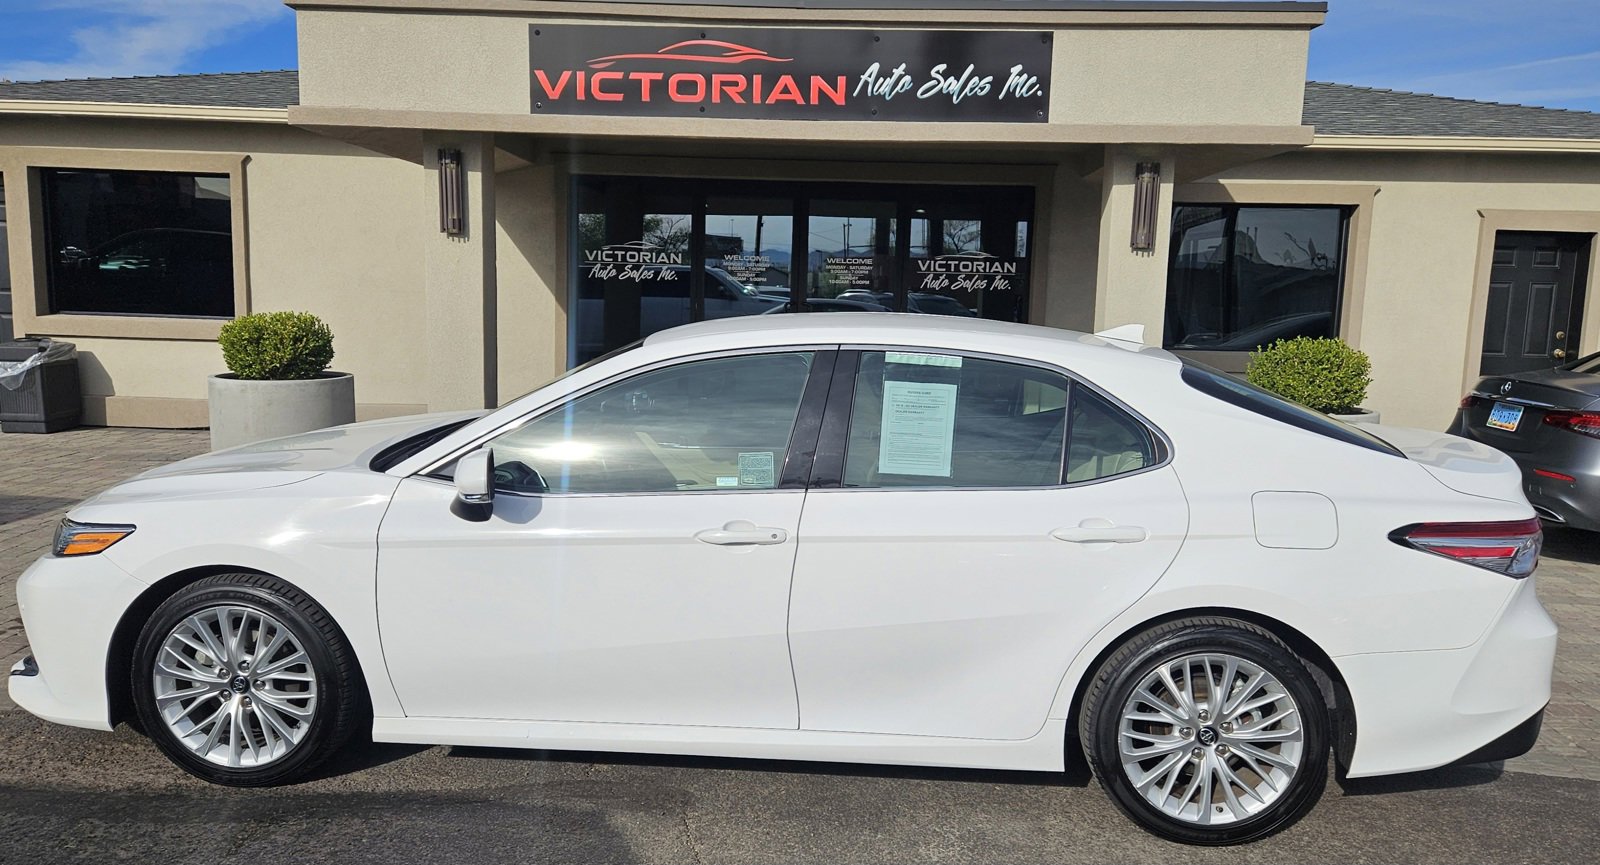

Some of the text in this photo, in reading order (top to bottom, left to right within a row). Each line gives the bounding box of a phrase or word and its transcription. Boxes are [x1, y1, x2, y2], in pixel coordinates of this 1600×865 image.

[534, 63, 1044, 106] VICTORIAN Auto Sales Inc.
[585, 250, 682, 264] VICTORIAN
[588, 264, 679, 282] Auto Sales Inc.
[918, 260, 1016, 273] VICTORIAN
[920, 273, 1012, 292] Auto Sales Inc.
